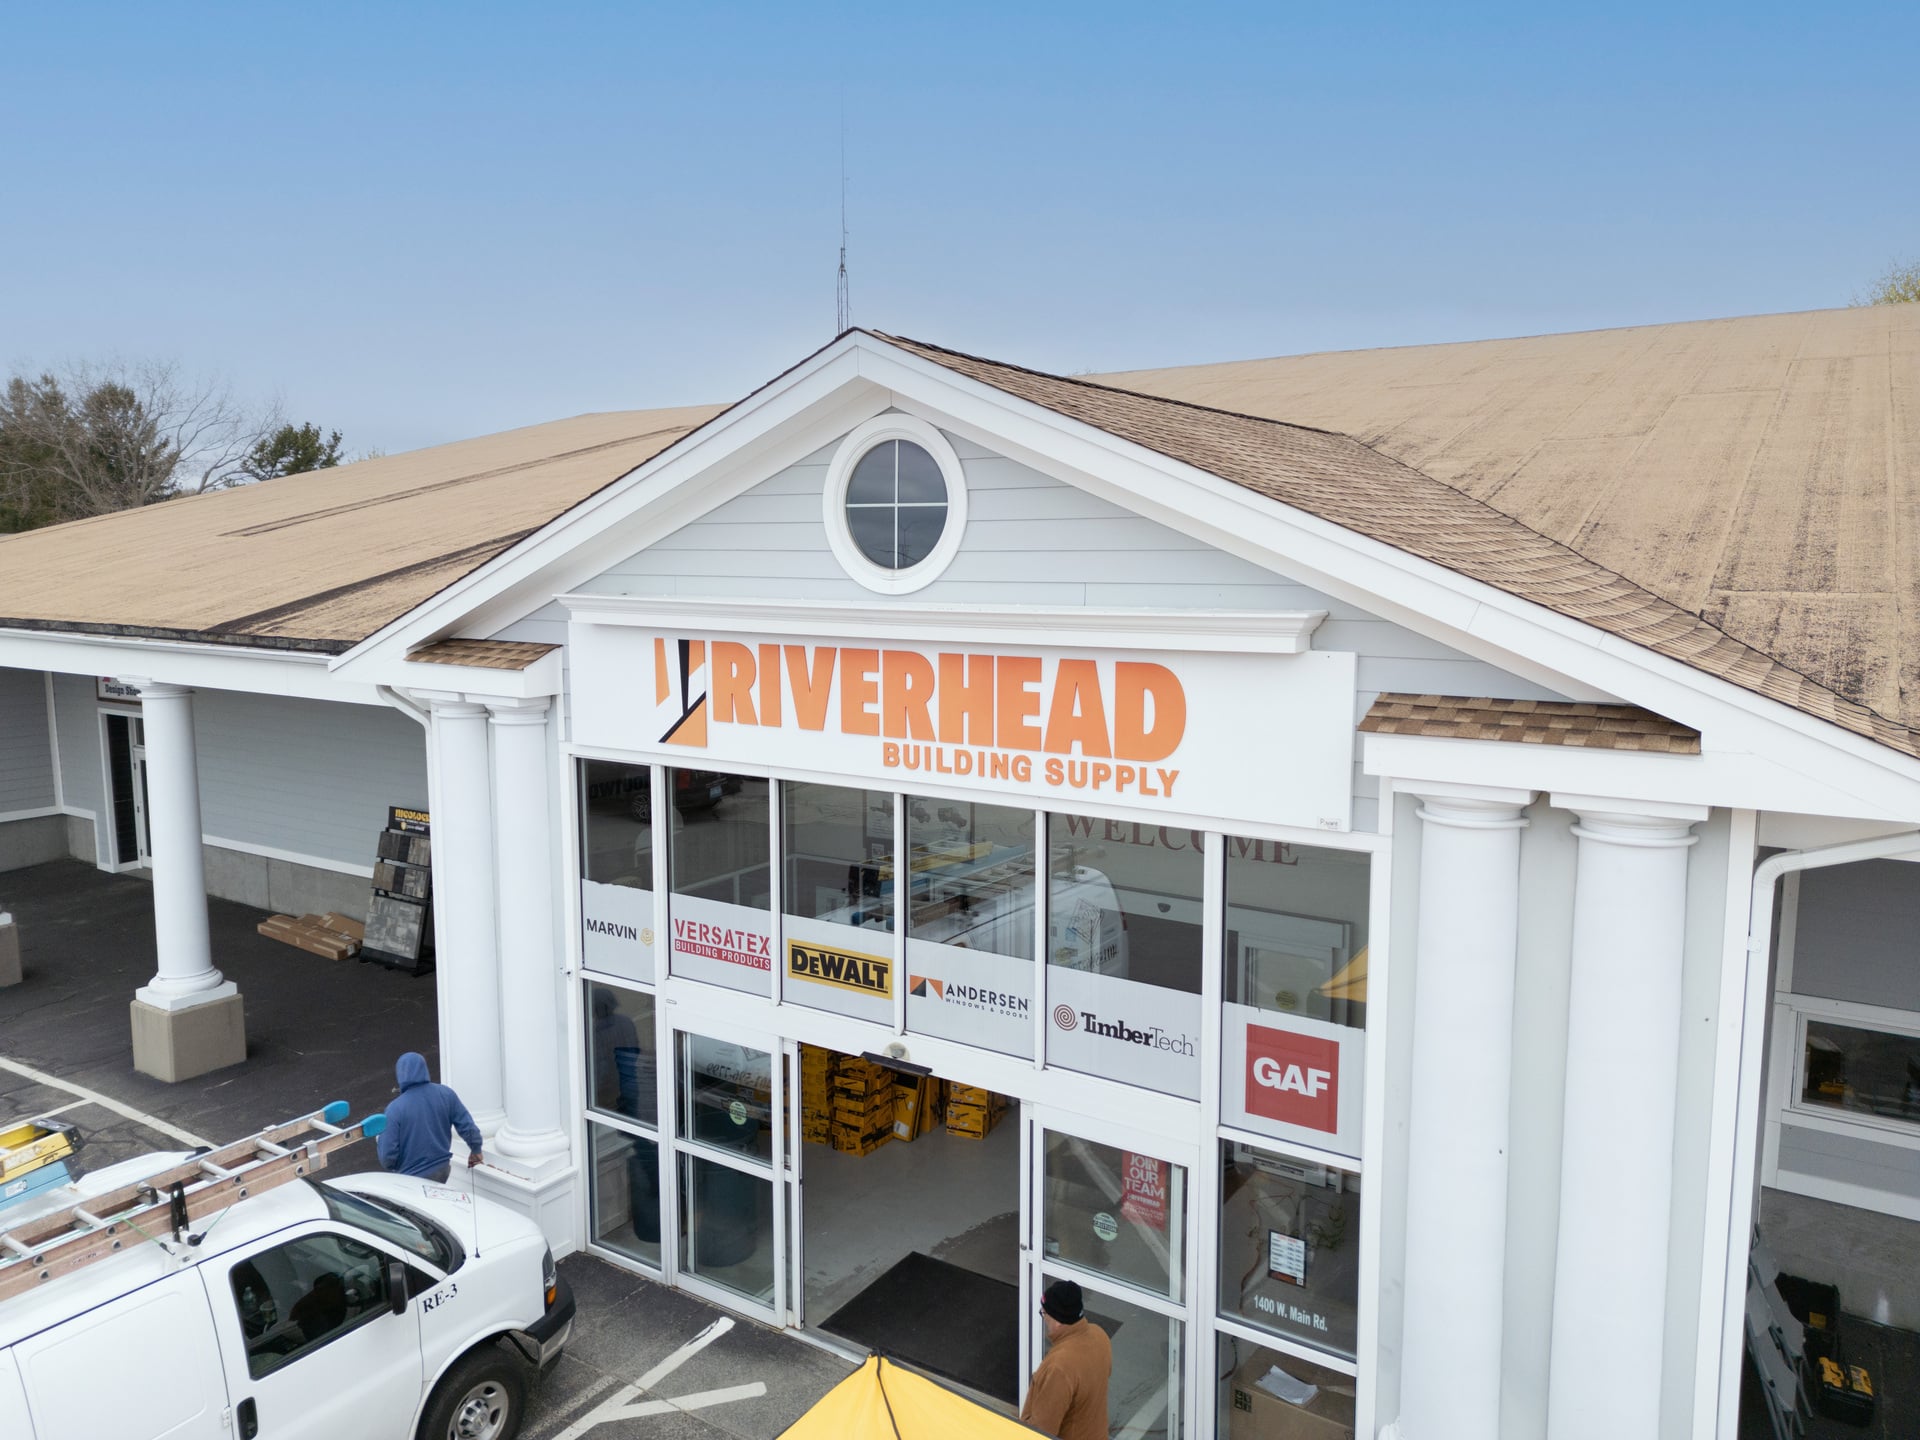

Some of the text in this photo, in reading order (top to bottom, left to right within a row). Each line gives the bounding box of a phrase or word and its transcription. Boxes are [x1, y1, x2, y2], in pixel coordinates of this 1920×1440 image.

[711, 641, 1187, 763] RIVERHEAD
[883, 742, 1180, 798] BUILDING SUPPLY
[586, 918, 637, 941] MARVIN
[674, 918, 771, 957] VERSATEX
[675, 940, 771, 970] BUILDING PRODUCTS
[945, 983, 1029, 1012] ANDERSEN
[945, 997, 985, 1011] WINDOWS
[999, 1009, 1029, 1020] DOORS
[1080, 1011, 1195, 1057] TimberTech
[1252, 1057, 1331, 1098] GAF
[1129, 1167, 1159, 1185] OUR
[1130, 1153, 1159, 1172] JOIN
[1124, 1177, 1164, 1200] TEAM
[422, 1283, 458, 1314] RE-3
[1254, 1294, 1328, 1332] 1400 W. Main Rd.
